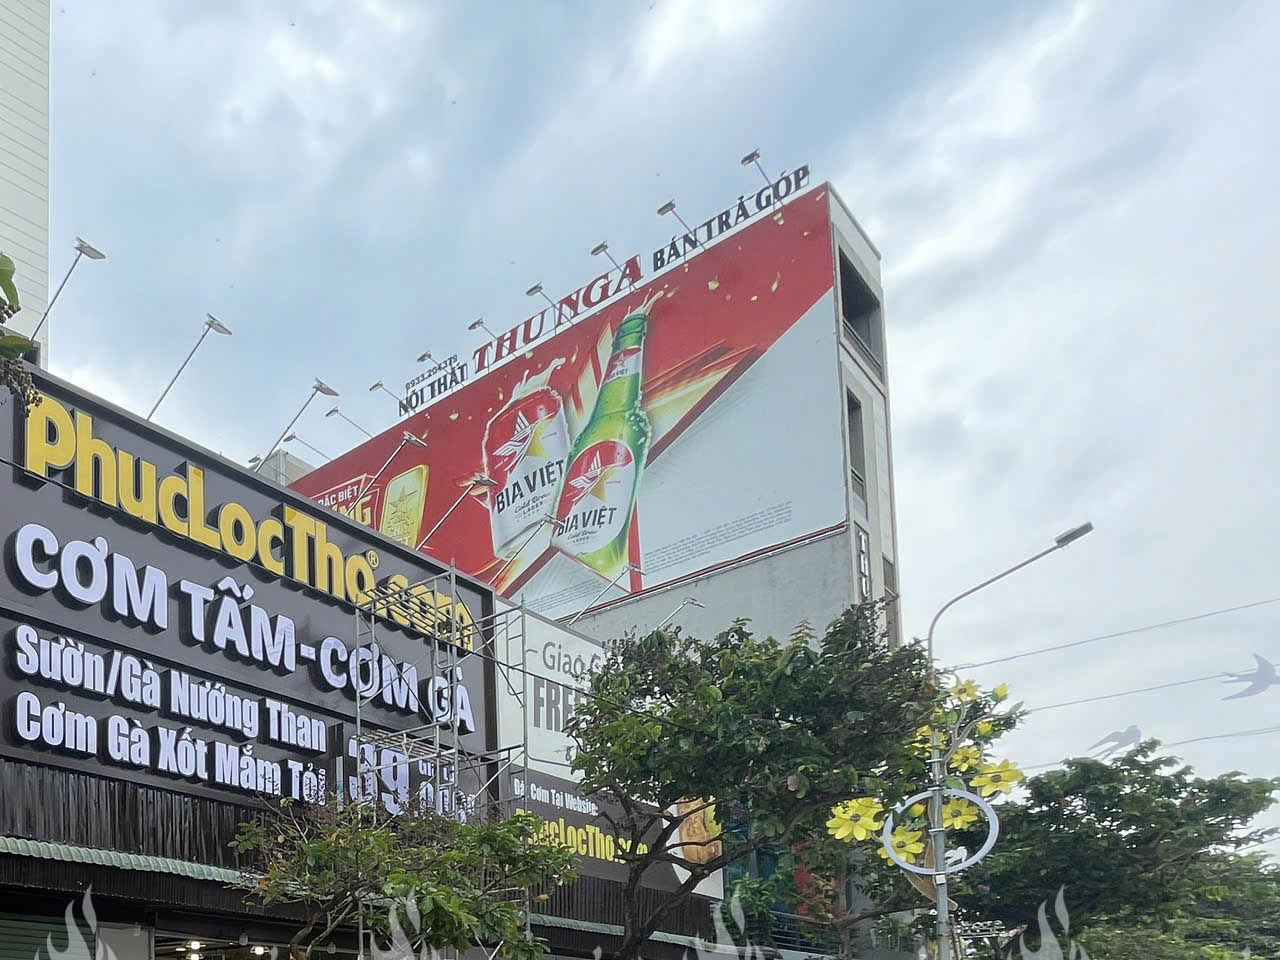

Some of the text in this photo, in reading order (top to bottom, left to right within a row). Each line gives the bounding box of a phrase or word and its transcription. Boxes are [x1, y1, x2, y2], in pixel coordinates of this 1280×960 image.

[472, 312, 547, 374] THU
[556, 254, 644, 328] NGA
[755, 165, 810, 211] GÓP
[496, 459, 564, 514] BIA VIỆT
[582, 505, 617, 529] VIỆT
[15, 523, 168, 632] CƠM
[16, 691, 97, 753] Cơm
[108, 715, 150, 766] Gà
[157, 728, 208, 780] Xốt
[215, 741, 281, 796] Mắm
[171, 669, 258, 738] Nướng
[266, 698, 327, 753] Than
